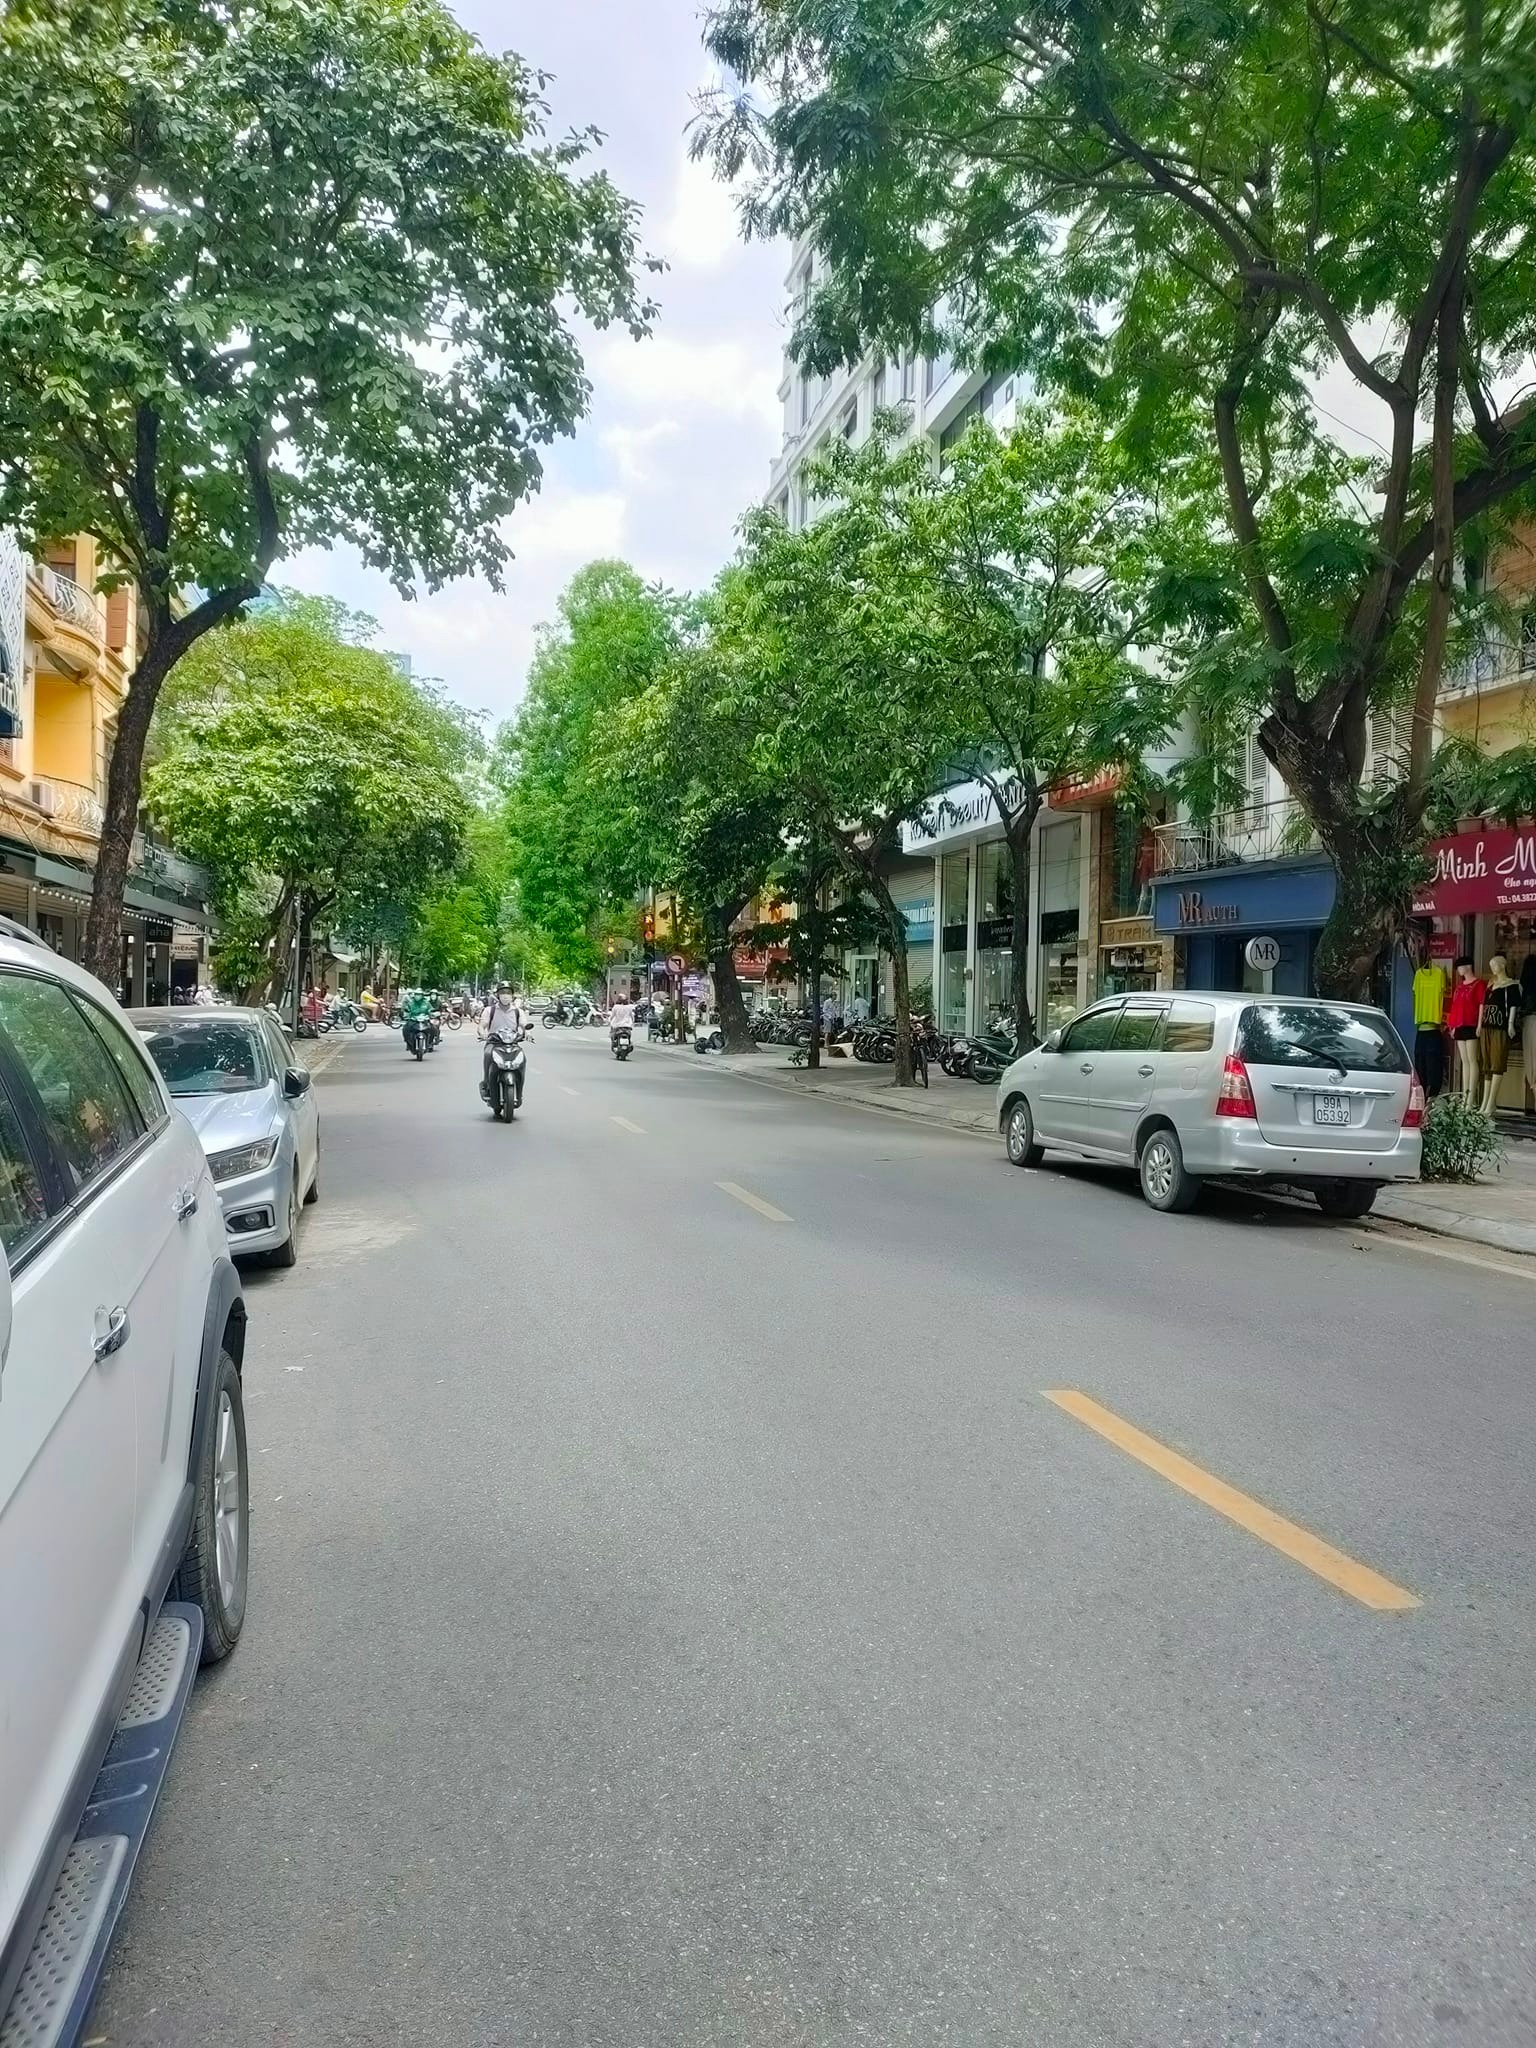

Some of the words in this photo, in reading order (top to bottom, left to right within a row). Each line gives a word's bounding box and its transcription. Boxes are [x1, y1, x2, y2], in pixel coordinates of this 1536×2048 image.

[1430, 841, 1488, 884] Minh
[1503, 877, 1521, 888] Cho
[1206, 904, 1238, 921] AUTH
[1254, 943, 1276, 961] MR
[1323, 1096, 1342, 1110] 99A
[1316, 1109, 1350, 1123] 053.92
